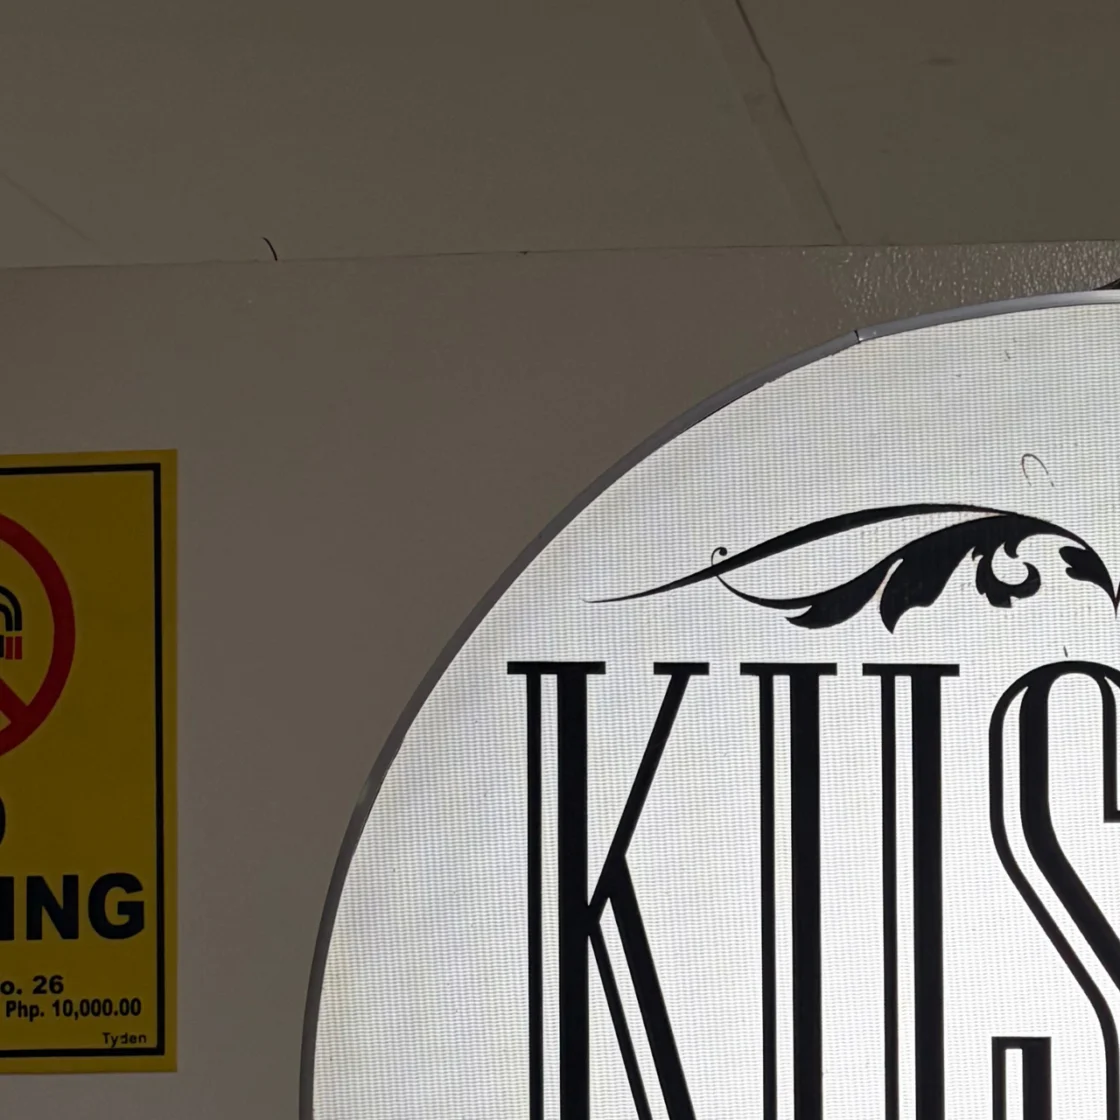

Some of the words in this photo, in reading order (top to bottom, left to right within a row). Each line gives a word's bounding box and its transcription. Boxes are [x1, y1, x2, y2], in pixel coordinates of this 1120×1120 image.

[32, 975, 64, 995] 26
[5, 1000, 45, 1022] Php.
[52, 997, 142, 1021] 10,000.00
